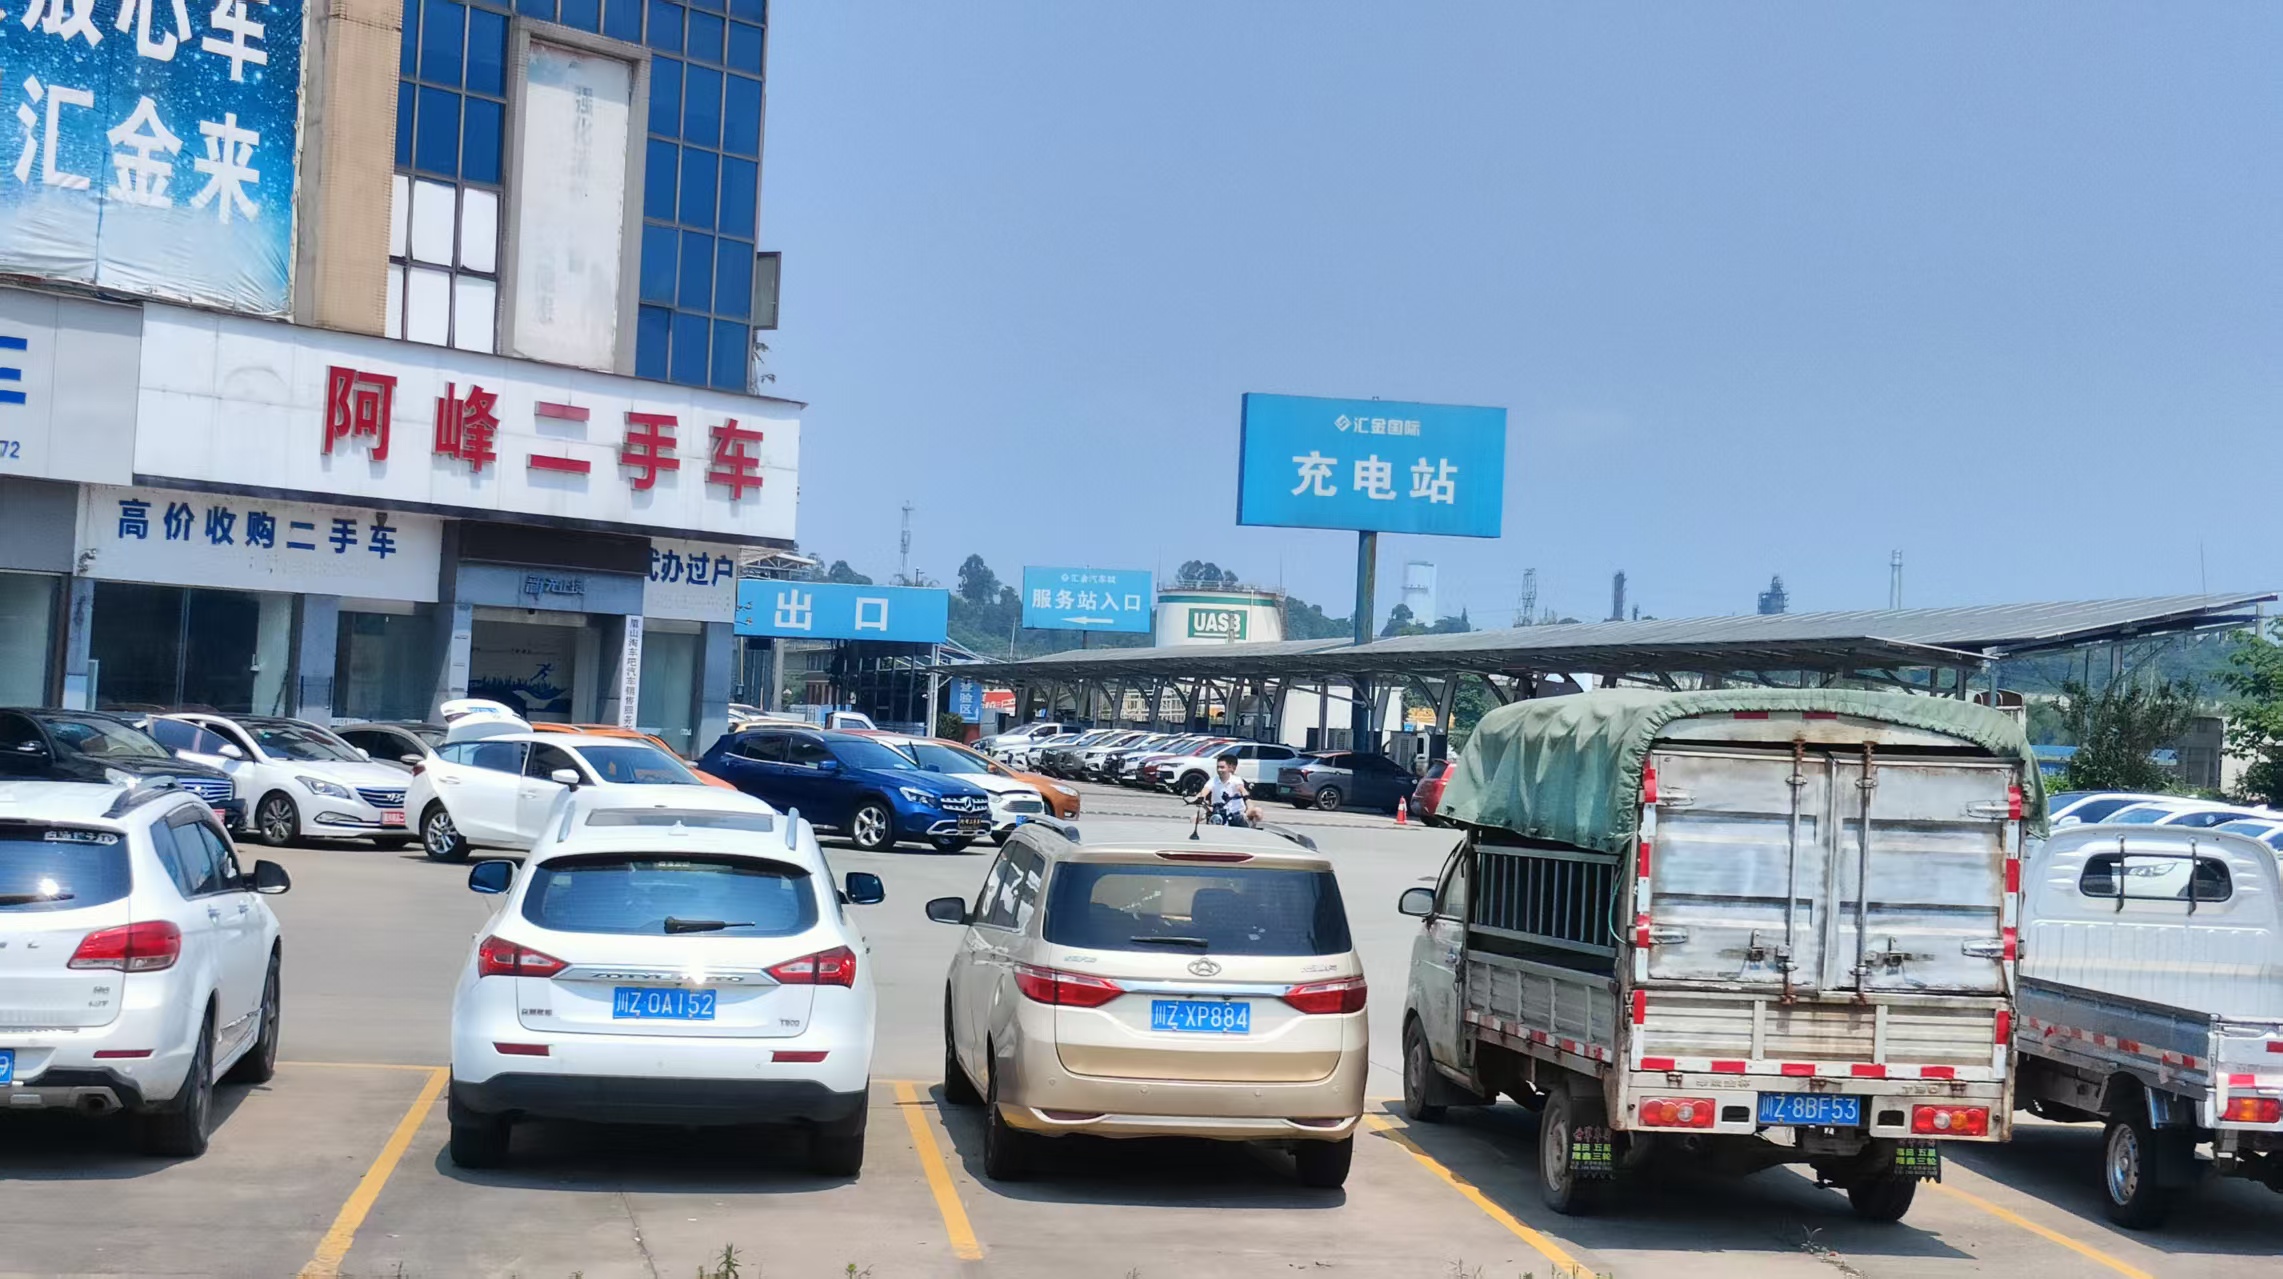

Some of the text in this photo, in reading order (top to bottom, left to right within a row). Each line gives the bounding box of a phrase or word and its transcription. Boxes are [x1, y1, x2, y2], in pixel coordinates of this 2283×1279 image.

[13, 74, 261, 225] 汇金来
[321, 365, 765, 501] 阿峰二手车
[1353, 416, 1421, 437] 汇金国际
[1291, 451, 1458, 505] 充电站
[118, 498, 398, 560] 高价收购二手车
[773, 589, 889, 632] 出口
[1031, 588, 1142, 612] 服务站入口
[1193, 612, 1241, 632] UASB
